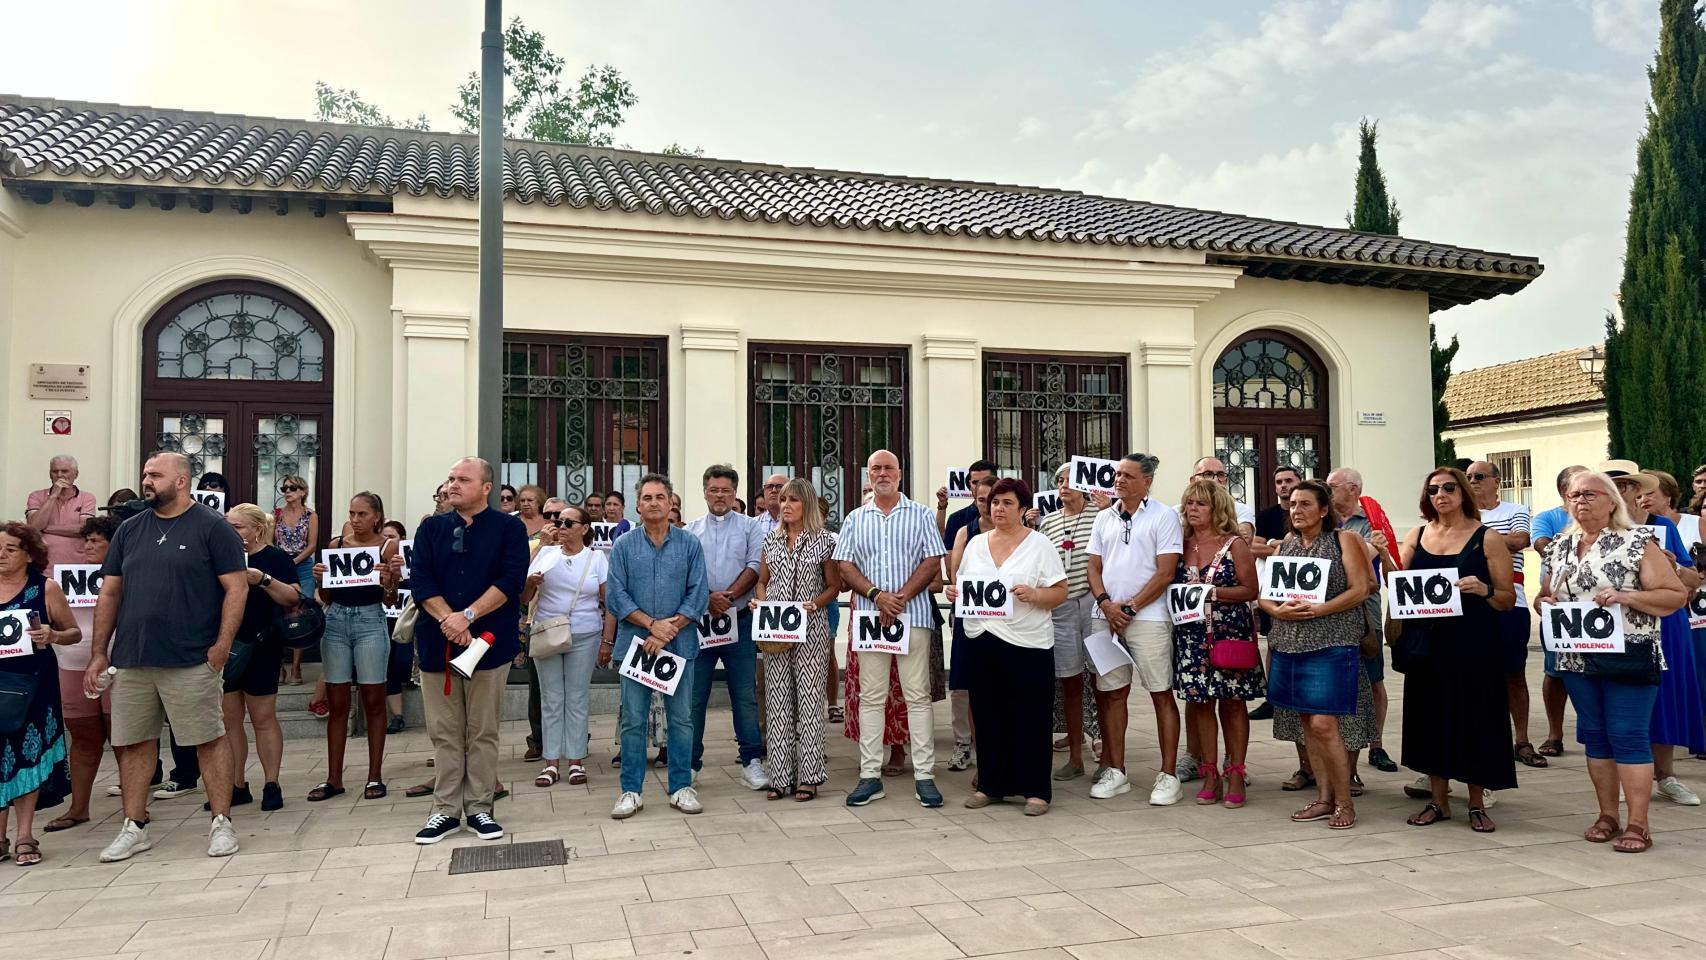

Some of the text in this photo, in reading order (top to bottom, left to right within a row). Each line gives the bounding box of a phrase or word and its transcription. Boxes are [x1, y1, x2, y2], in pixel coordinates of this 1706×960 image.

[949, 471, 971, 491] N
[0, 614, 23, 646] O
[705, 637, 732, 646] VIOLENCIA
[874, 644, 902, 652] VIOLENCIA
[641, 676, 668, 691] VIOLENCIA
